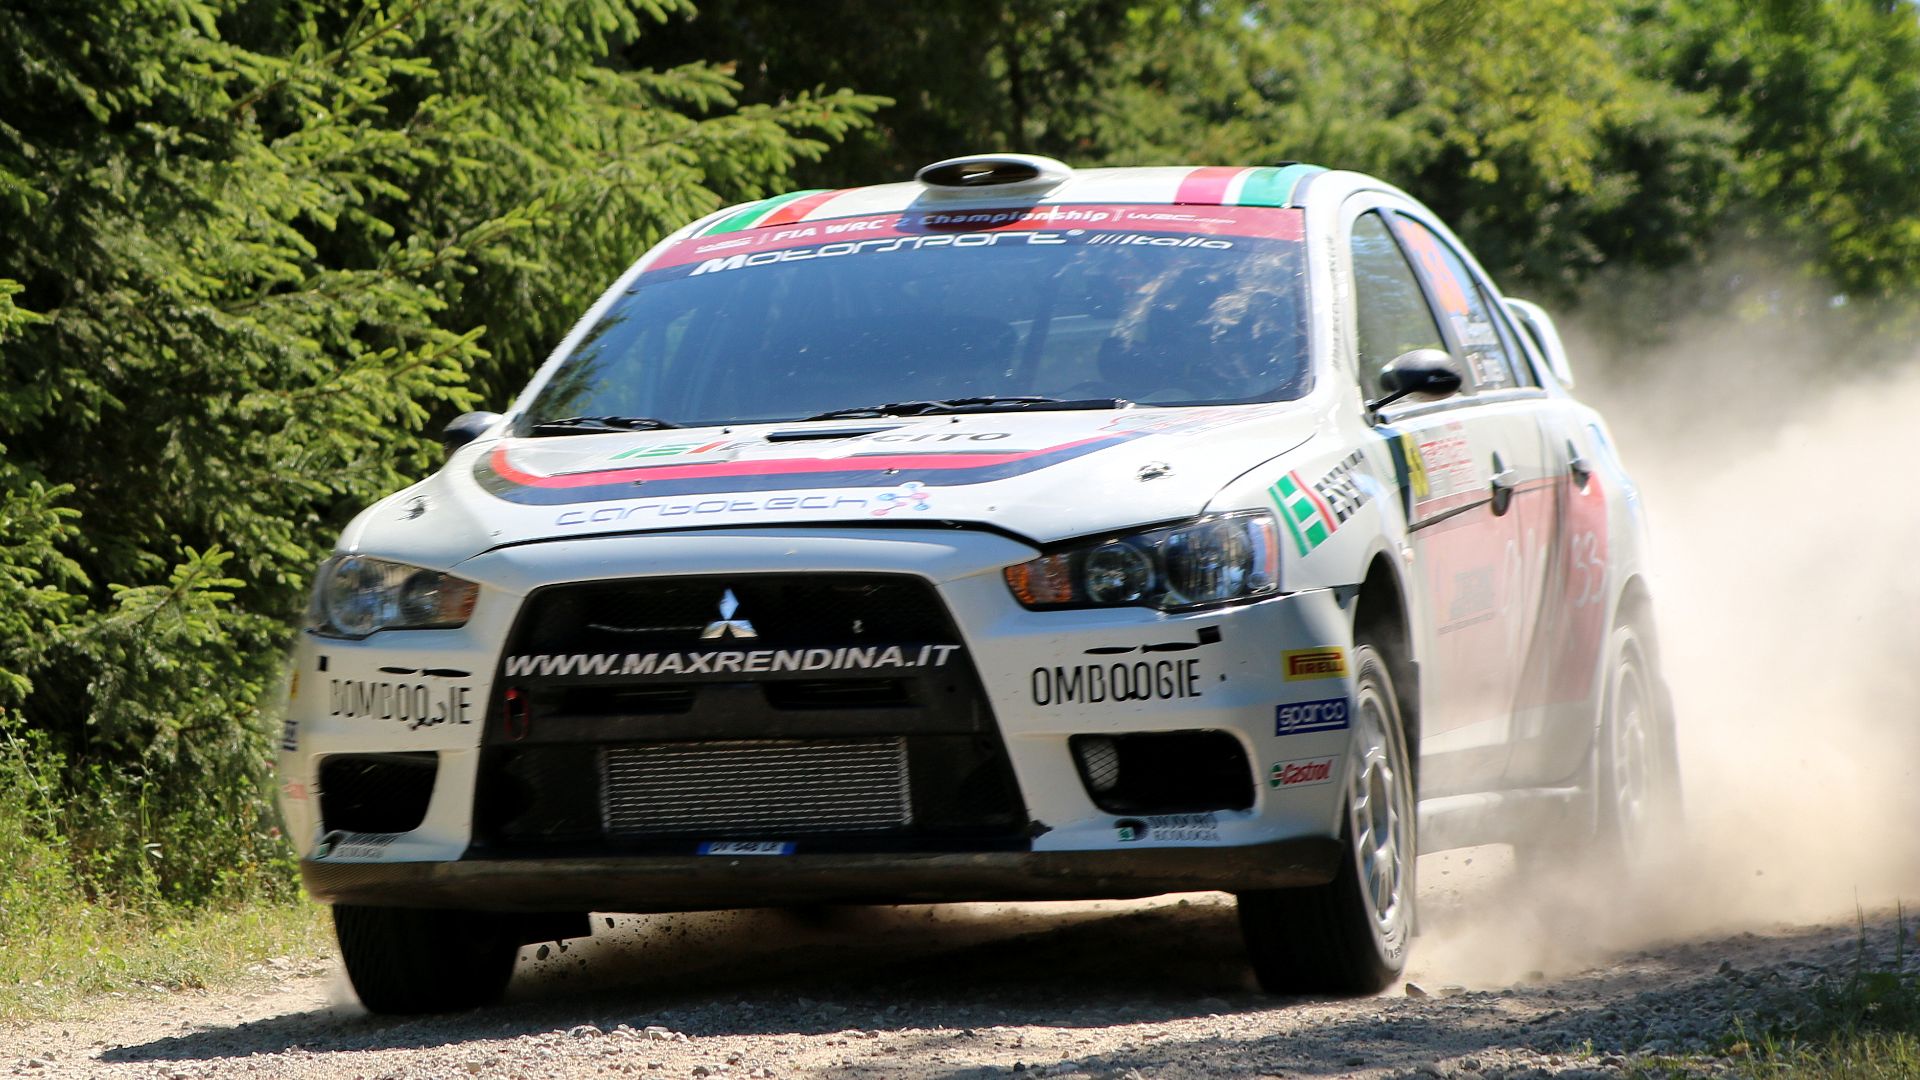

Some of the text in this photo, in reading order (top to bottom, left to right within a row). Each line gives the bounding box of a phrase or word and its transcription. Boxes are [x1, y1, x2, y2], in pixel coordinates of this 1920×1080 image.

[770, 227, 817, 242] FIA
[824, 219, 888, 235] WRC
[918, 208, 1108, 226] Championship
[555, 496, 868, 526] carbotech
[505, 644, 961, 677] WWW.MAXRENDINA.IT
[1289, 652, 1346, 676] PIRELLI
[1279, 701, 1347, 732] sparco
[1282, 759, 1333, 785] Castrol
